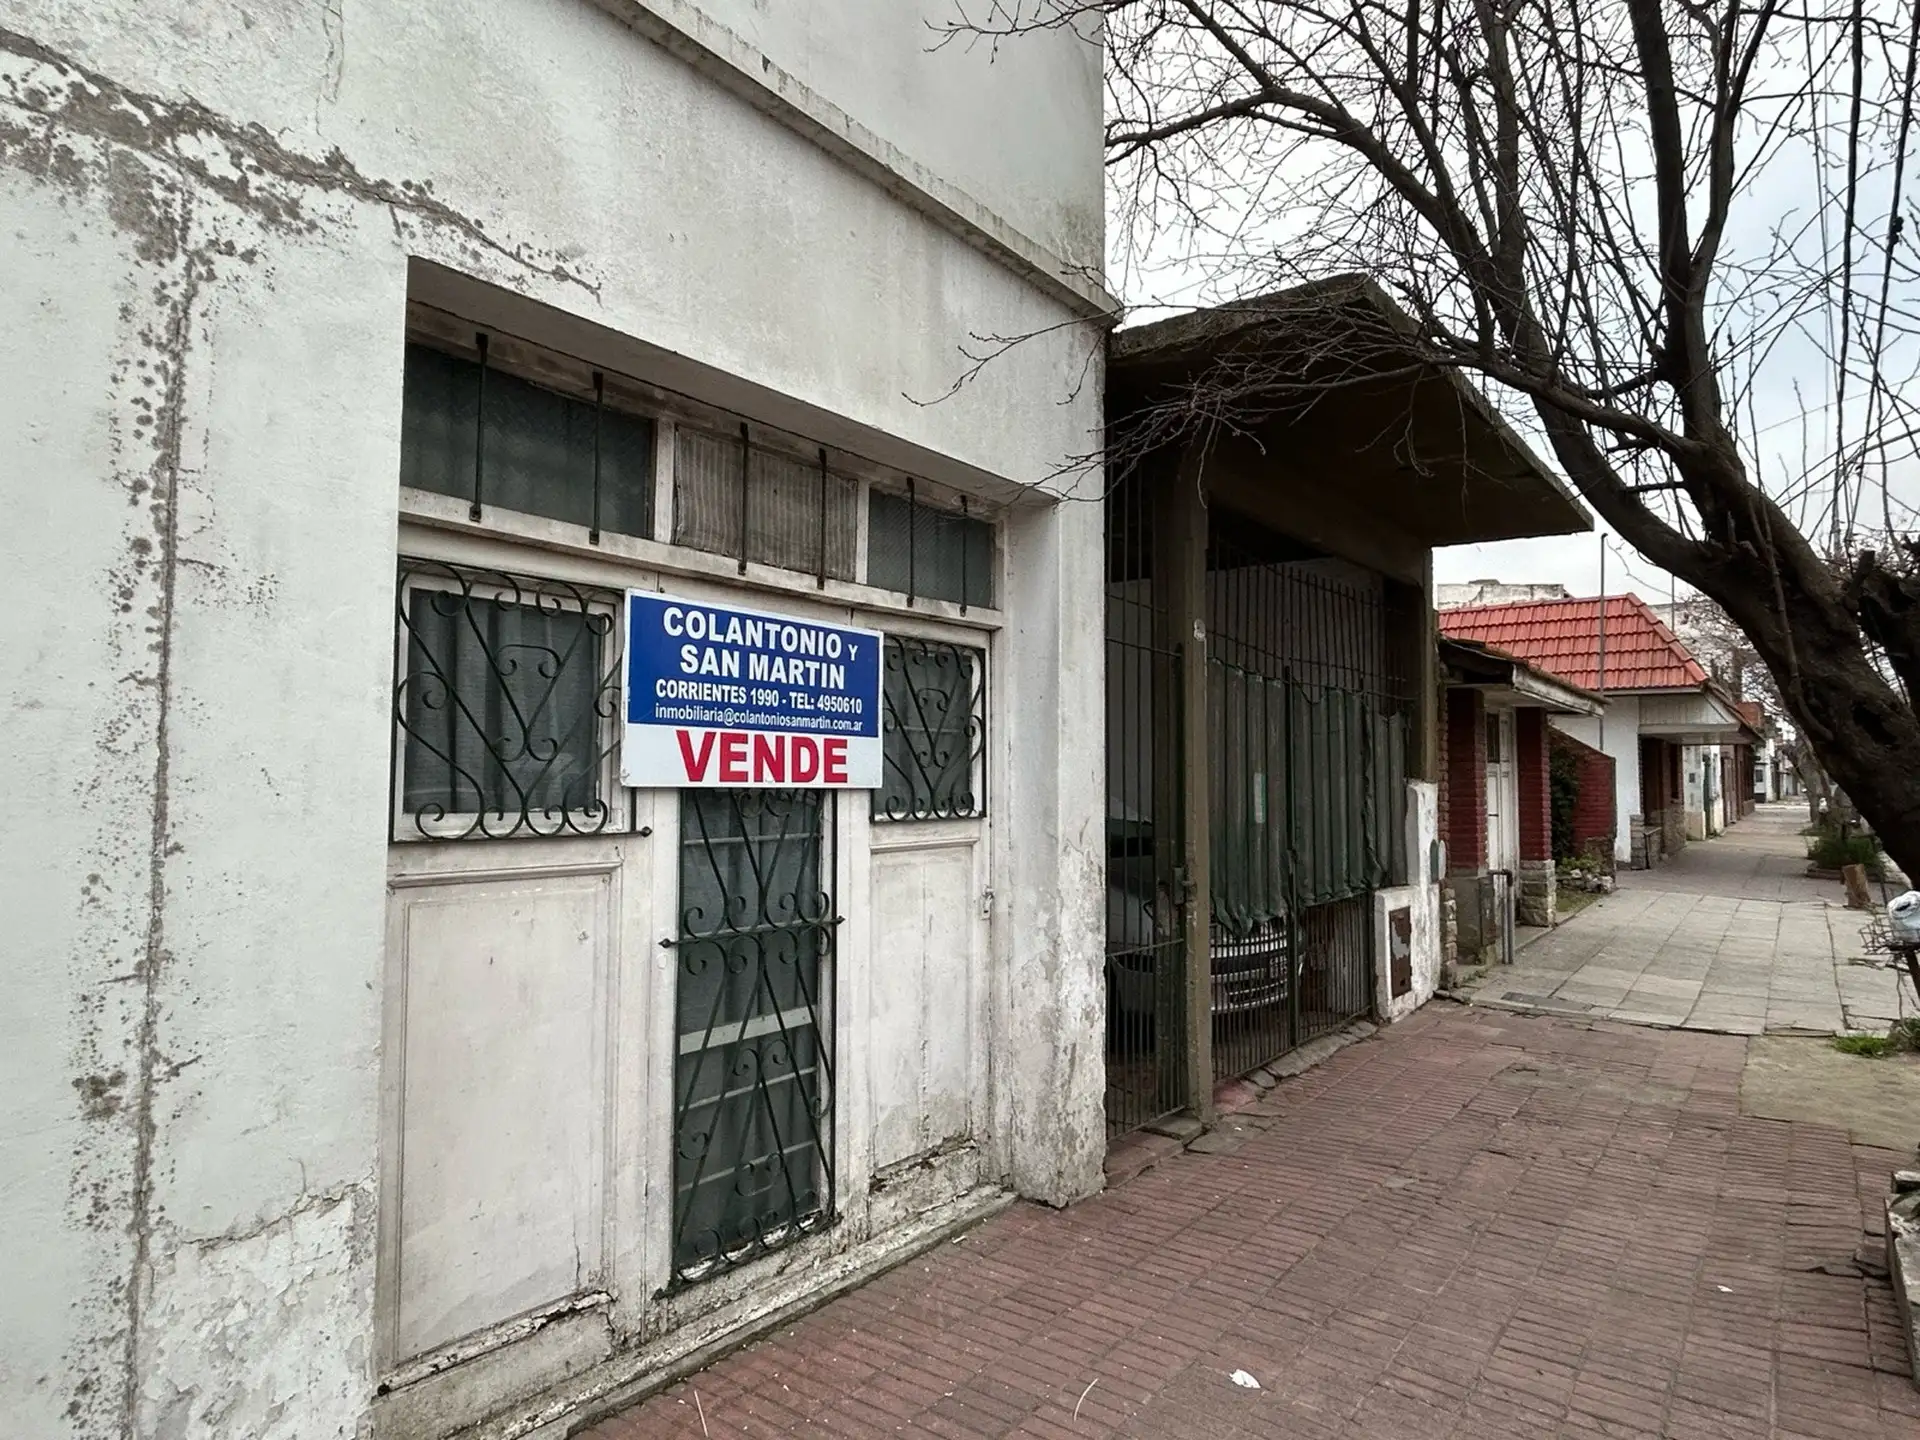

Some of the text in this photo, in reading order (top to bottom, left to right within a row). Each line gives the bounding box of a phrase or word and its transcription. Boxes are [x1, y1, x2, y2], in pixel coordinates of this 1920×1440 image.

[664, 607, 858, 661] COLANTONIO Y
[680, 645, 845, 690] SAN MARTIN
[655, 703, 863, 731] inmobiliaria@colantoniosanmartin.com.ar
[656, 679, 746, 704] CORRIENTES
[750, 689, 780, 707] 1990
[790, 691, 815, 710] TEL:
[817, 695, 862, 714] 4950610
[676, 729, 848, 784] VENDE
